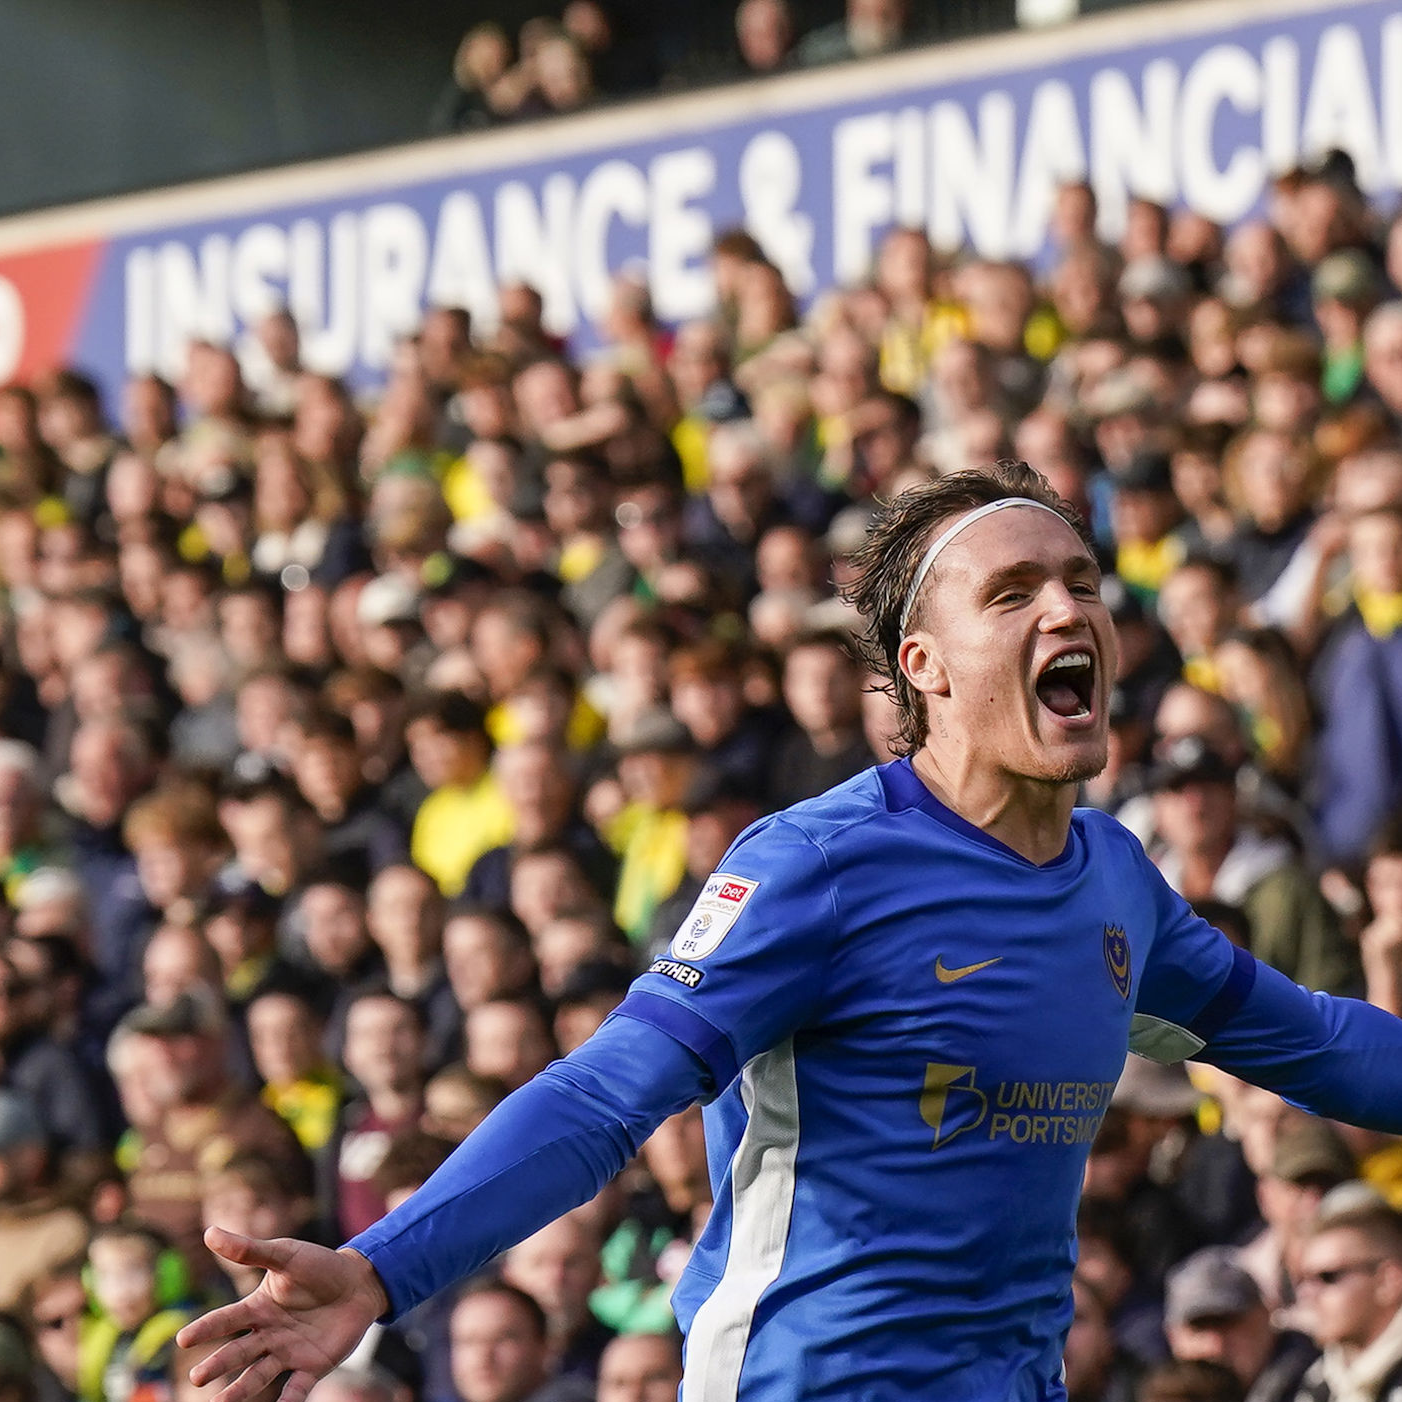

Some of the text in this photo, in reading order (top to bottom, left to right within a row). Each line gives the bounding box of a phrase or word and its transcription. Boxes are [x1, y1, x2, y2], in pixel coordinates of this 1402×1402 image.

[124, 145, 718, 382] INSURANCE
[739, 130, 816, 298] &
[721, 883, 745, 900] bet
[681, 940, 699, 952] EFL
